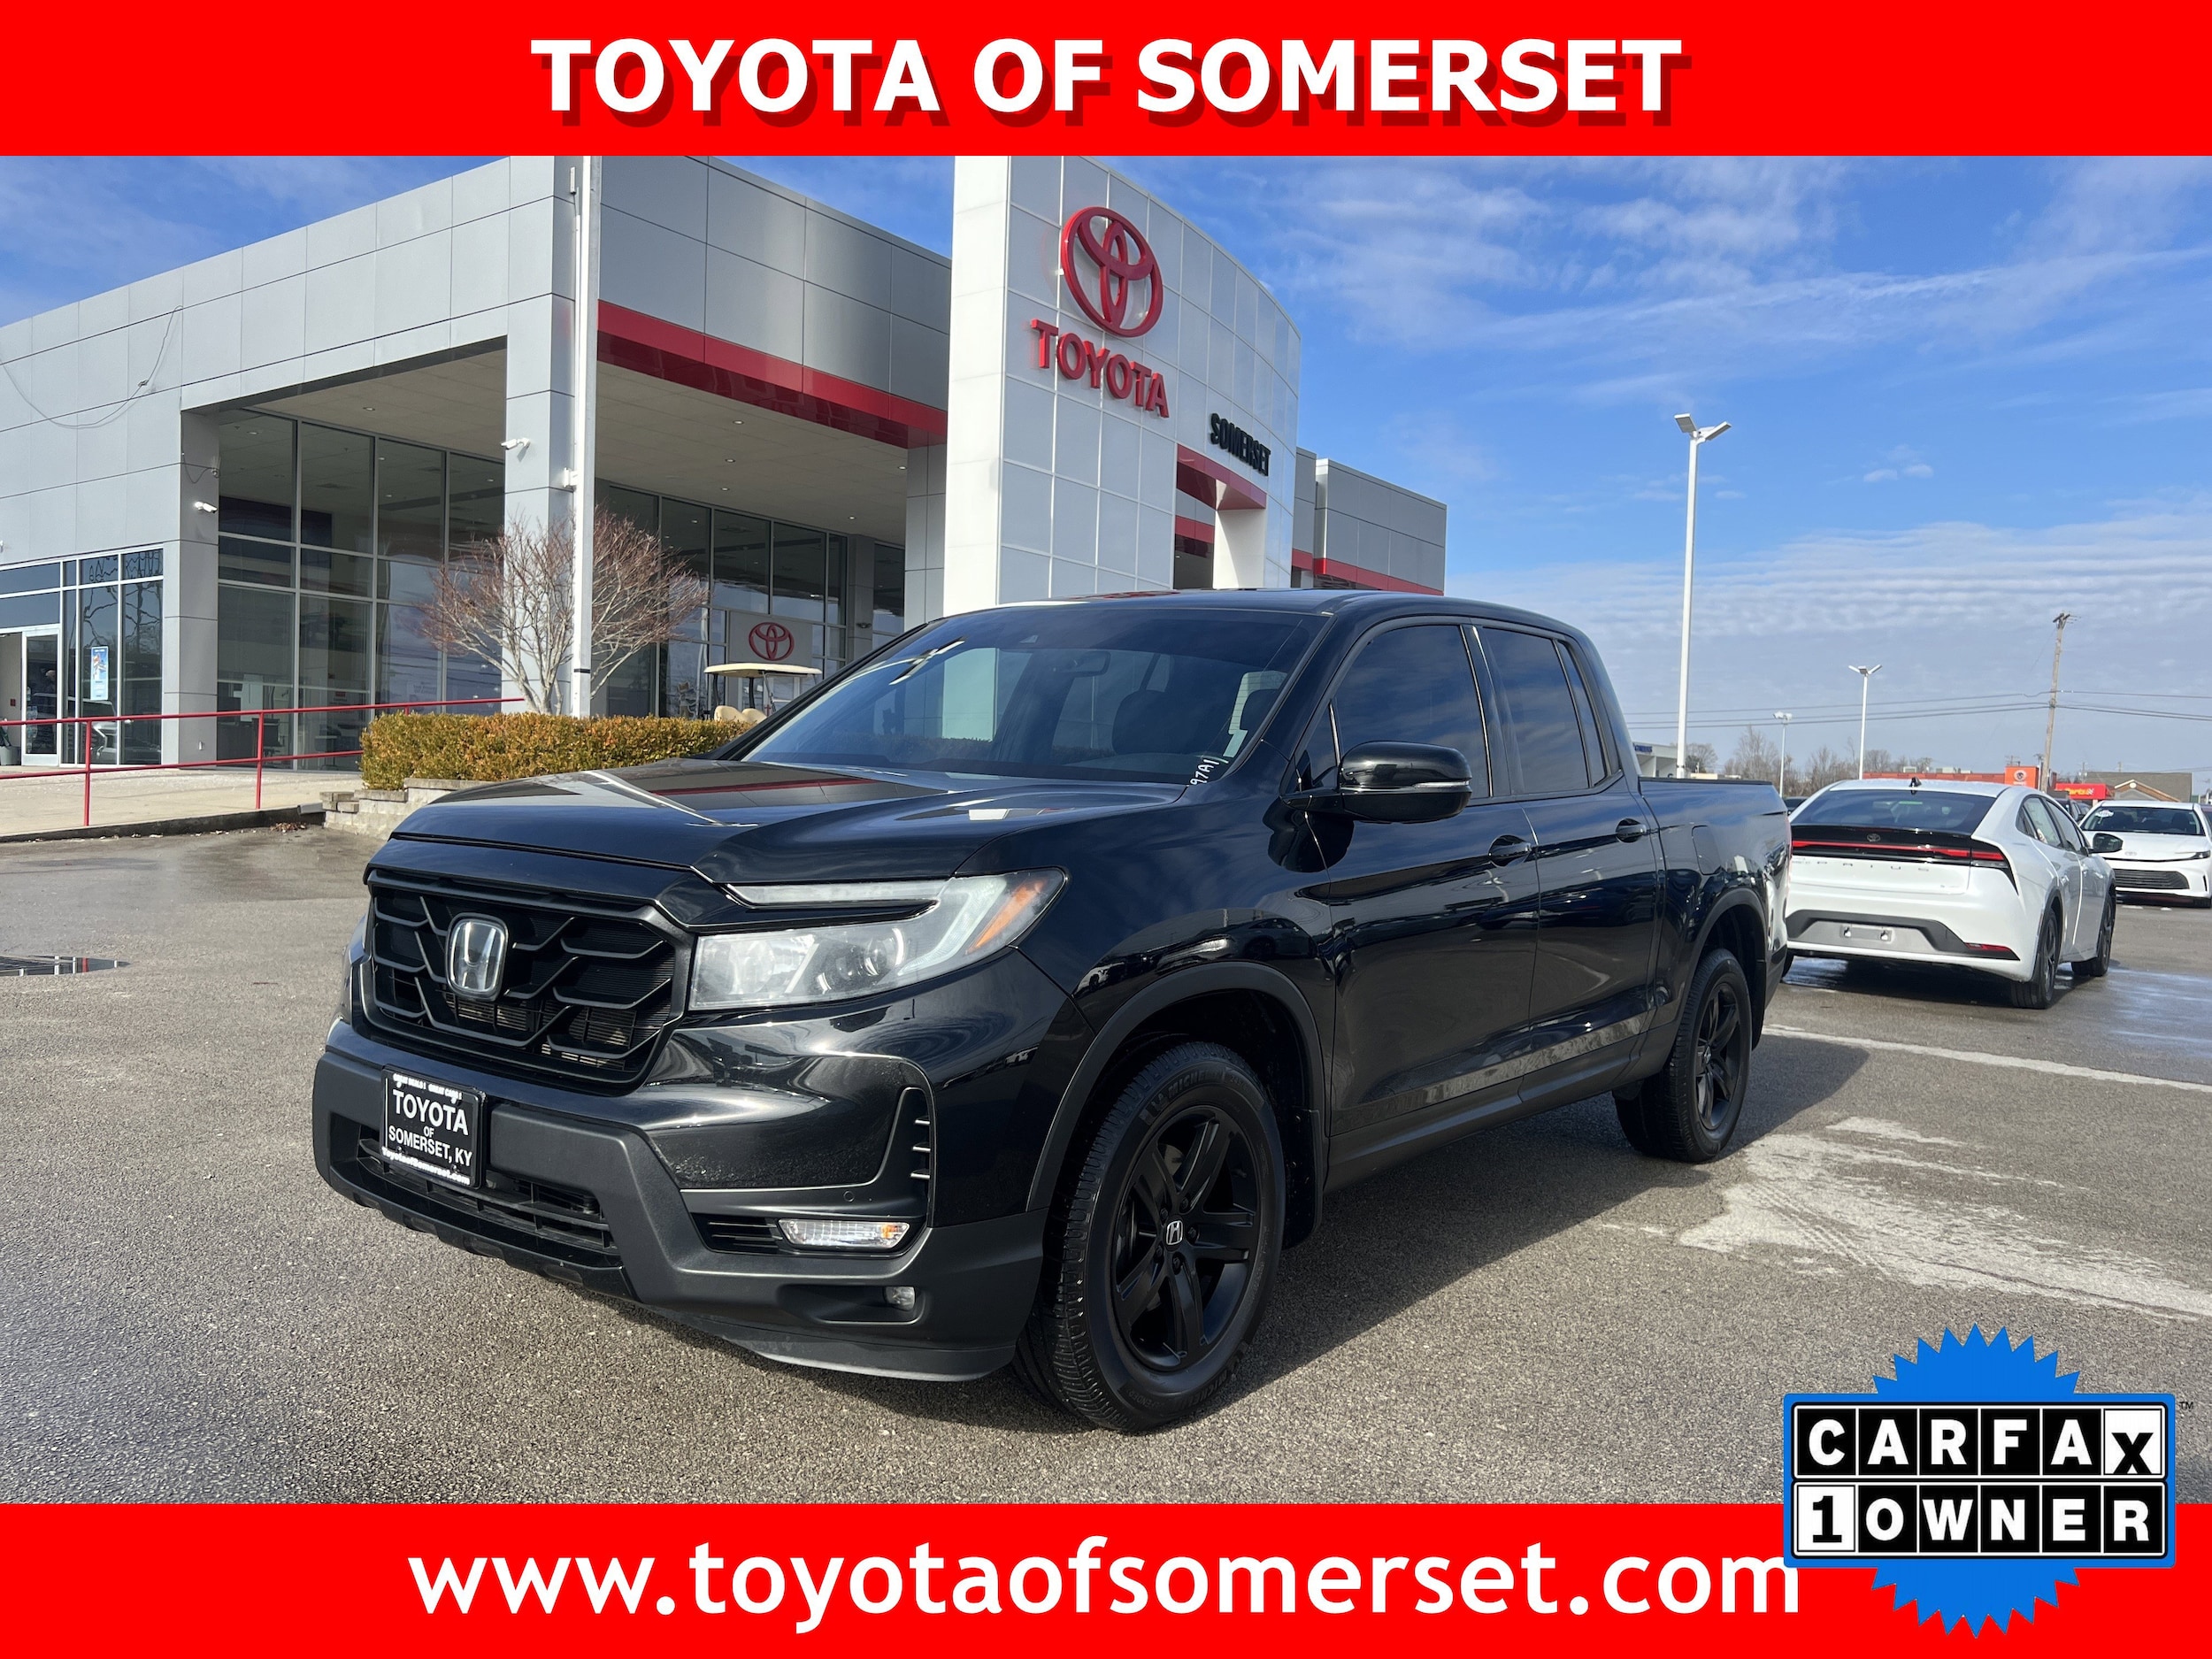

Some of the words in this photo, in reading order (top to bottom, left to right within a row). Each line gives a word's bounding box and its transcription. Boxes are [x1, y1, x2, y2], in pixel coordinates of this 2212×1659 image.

[1031, 319, 1170, 419] TOYOTA
[1210, 412, 1271, 476] SOMERSET
[393, 1089, 469, 1136] TOYOTA
[424, 1125, 434, 1138] OF
[388, 1125, 452, 1164] SOMERSET,
[455, 1148, 472, 1167] KY
